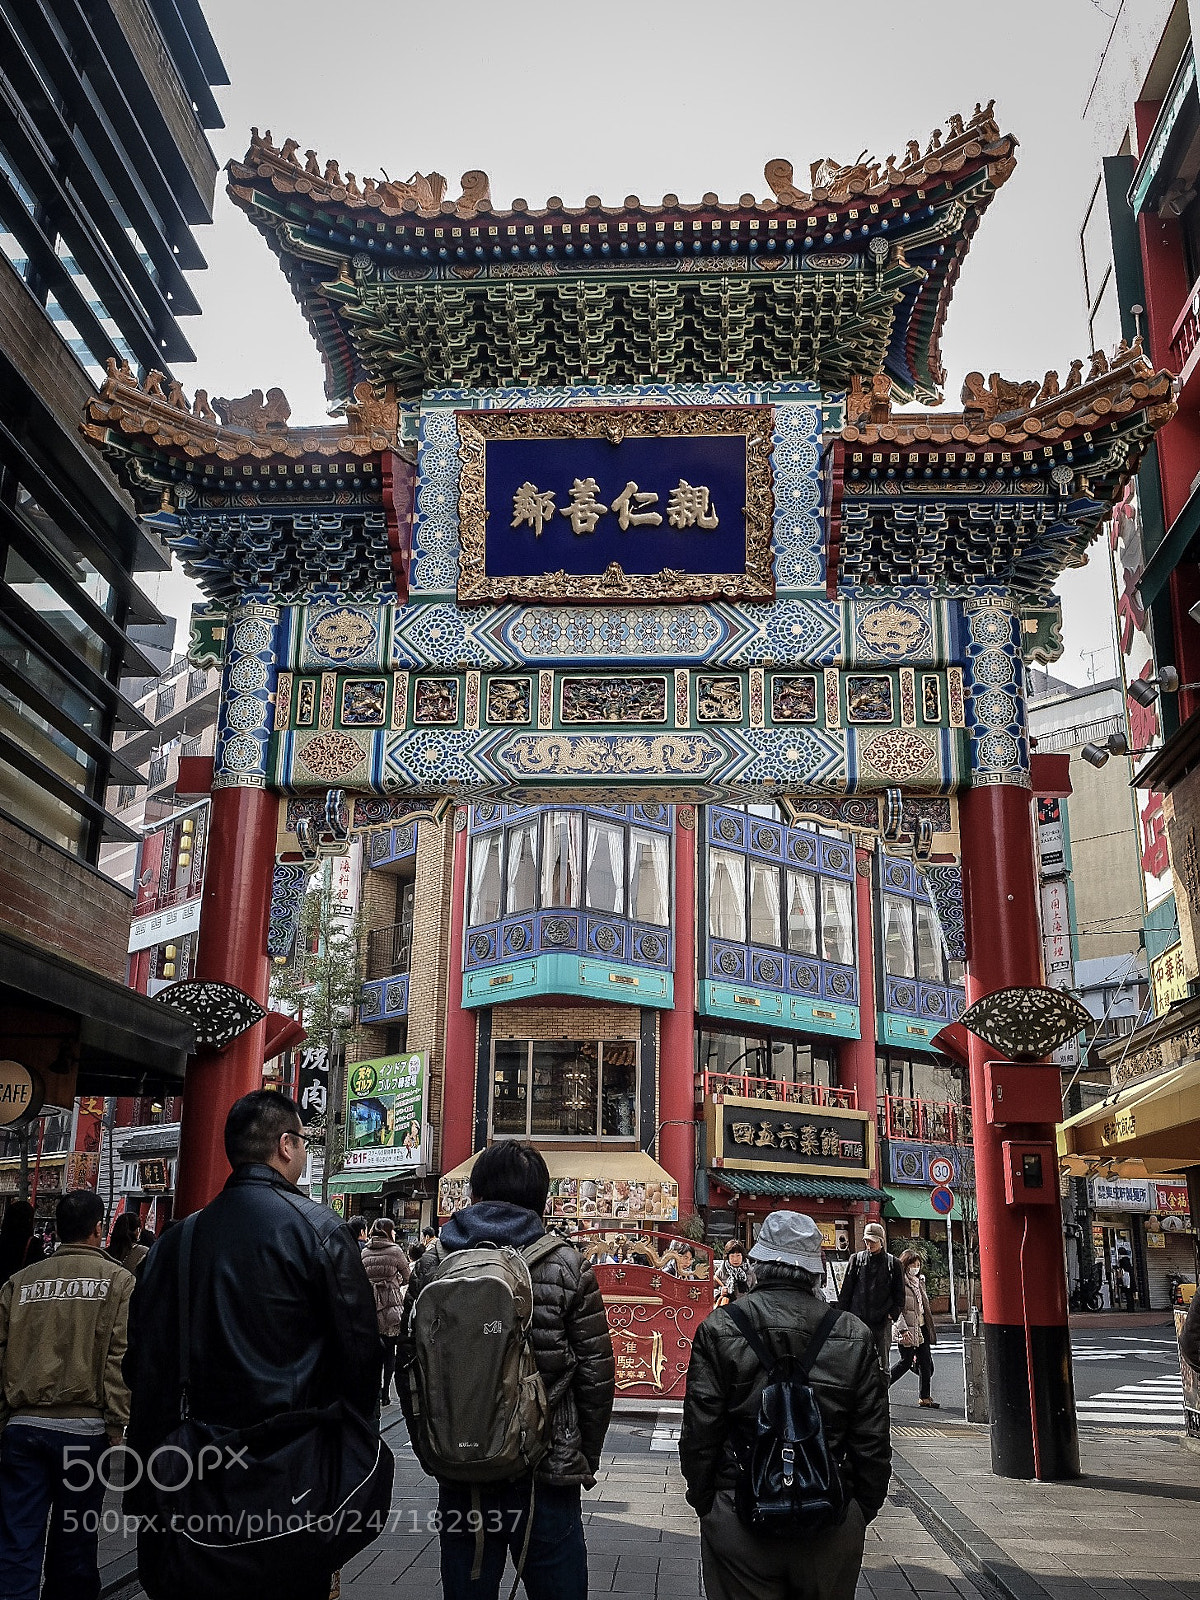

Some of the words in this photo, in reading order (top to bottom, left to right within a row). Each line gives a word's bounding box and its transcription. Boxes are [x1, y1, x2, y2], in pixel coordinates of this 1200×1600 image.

[379, 1060, 407, 1077] インドア
[934, 1165, 949, 1178] 30
[20, 1280, 110, 1304] FELLOWS
